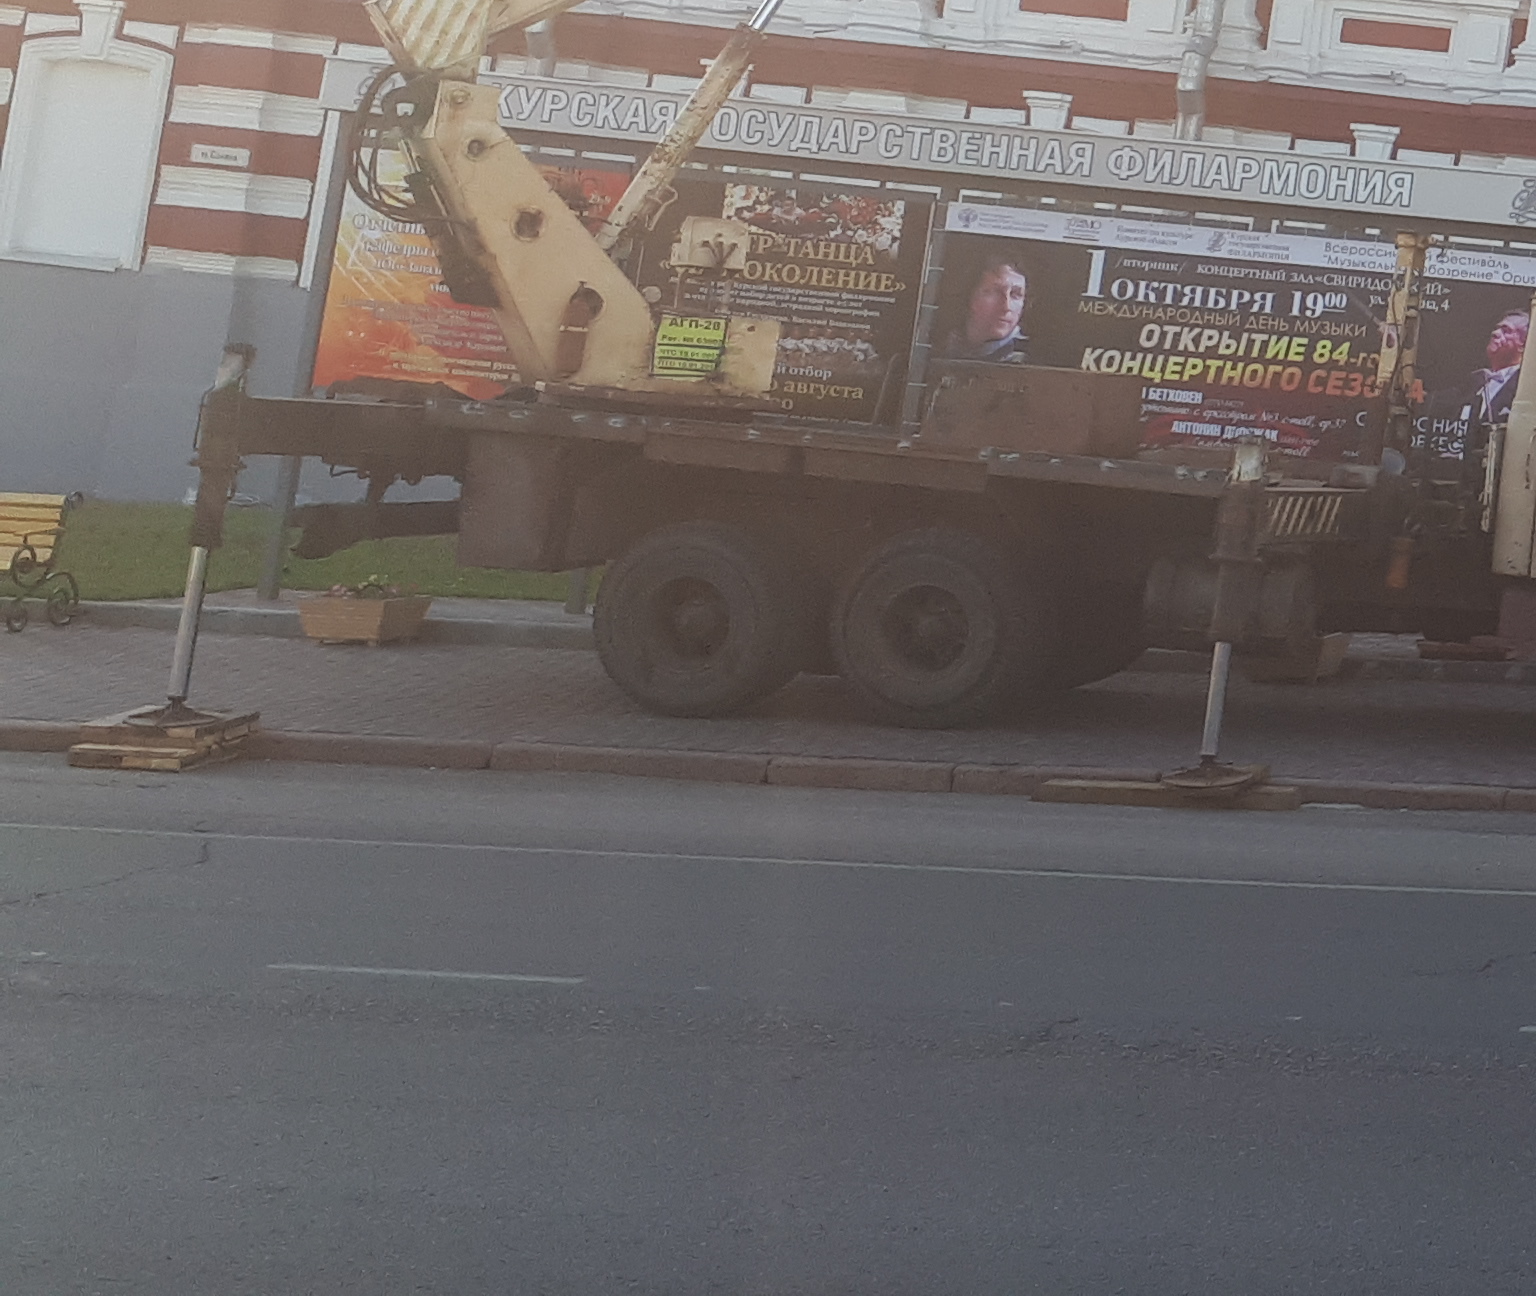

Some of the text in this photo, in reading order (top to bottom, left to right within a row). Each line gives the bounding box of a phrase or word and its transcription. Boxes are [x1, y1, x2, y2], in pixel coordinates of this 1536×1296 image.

[711, 105, 1095, 178] ОСУДАРСТВЕННАЯ
[1107, 146, 1414, 207] ФИЛАРМОНИЯ
[786, 237, 875, 267] ТАНЦА
[724, 260, 907, 293] ОКОЛЕНИЕ»
[1197, 263, 1286, 281] КОНЦЕРТНЫЙ
[1502, 273, 1536, 287] Opus
[1111, 278, 1276, 315] ОКТЯБРЯ
[1077, 301, 1367, 338] МЕЖДУНАРОДНЫЙ ДЕНЬ МУЗЫКИ
[1139, 324, 1309, 361] ОТКРЫТИЕ
[784, 380, 864, 400] августа
[1081, 348, 1427, 403] КОНЦЕРТНОГО СЕЗОА
